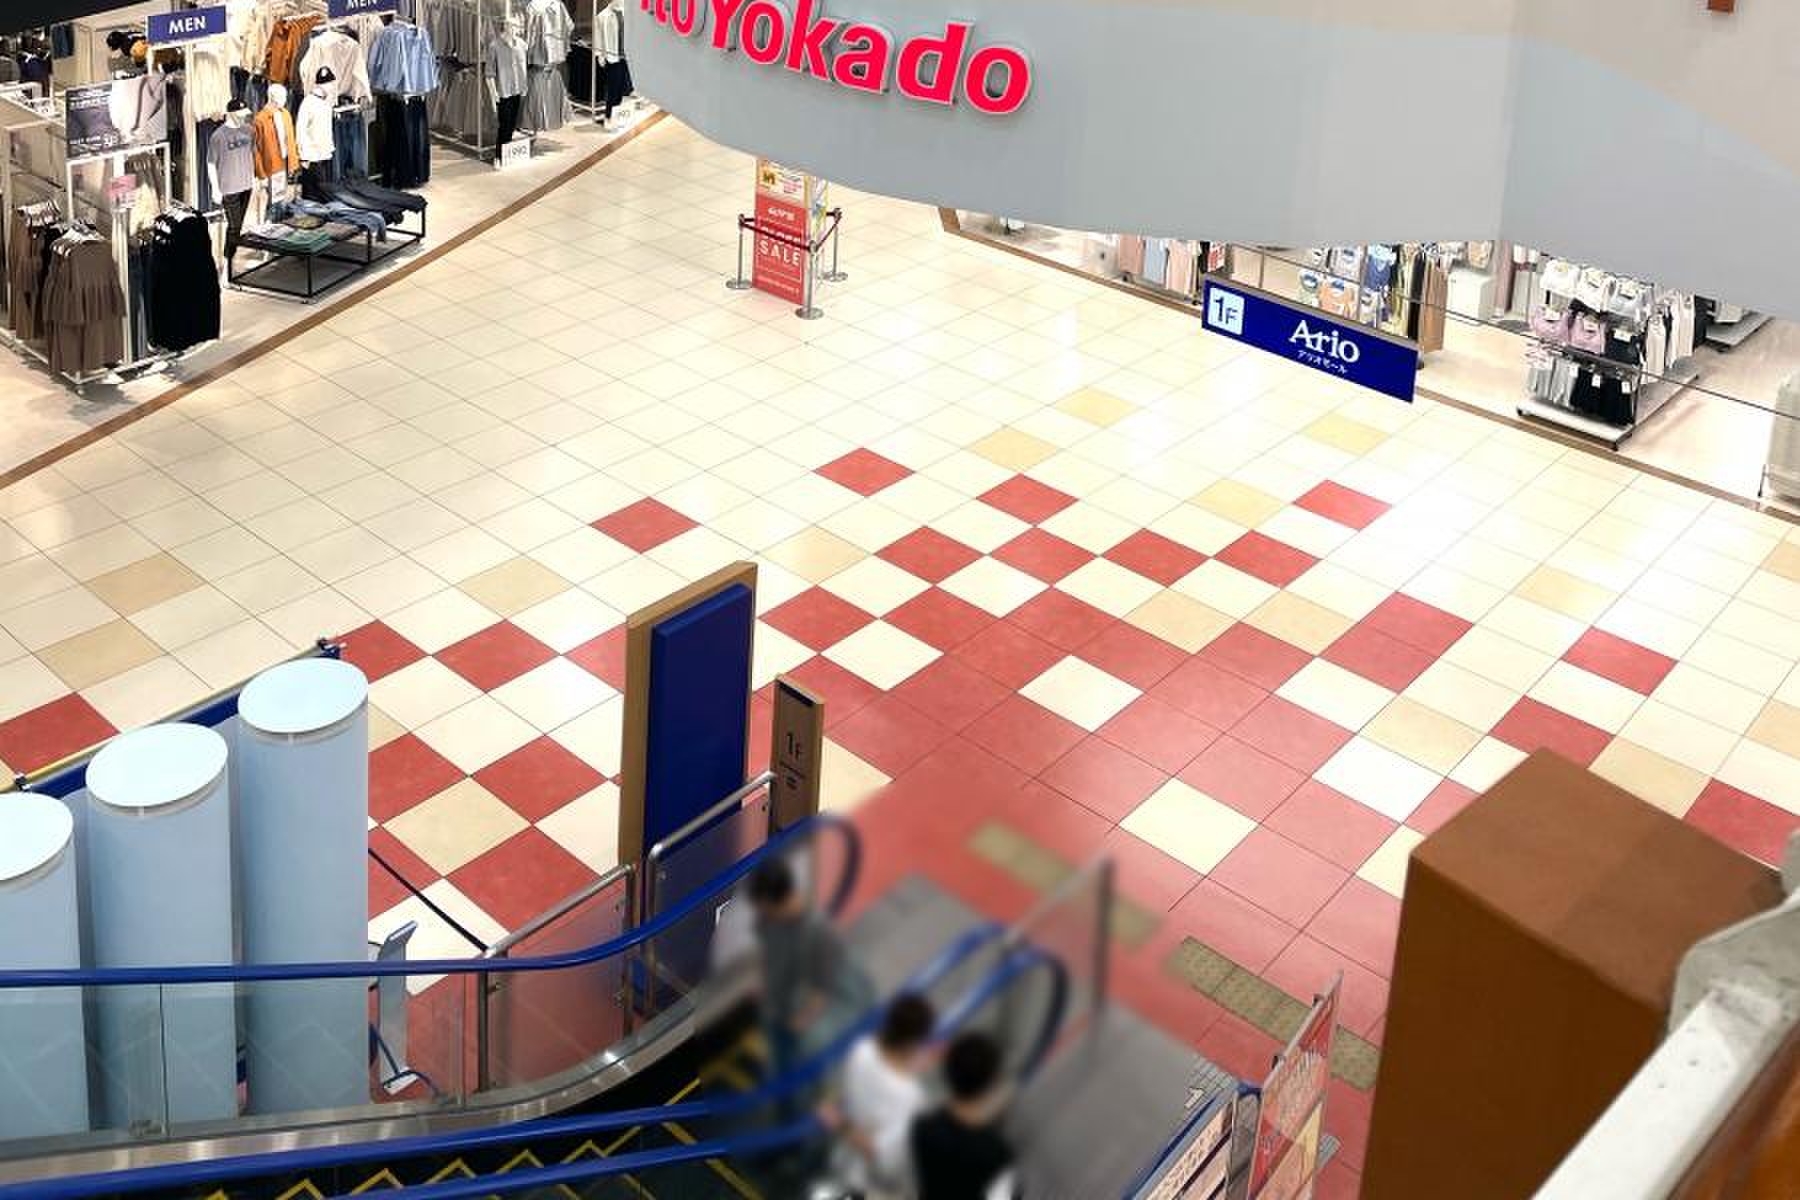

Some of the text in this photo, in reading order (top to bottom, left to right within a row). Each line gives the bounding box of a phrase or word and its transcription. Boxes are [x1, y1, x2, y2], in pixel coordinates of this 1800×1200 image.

[168, 14, 207, 35] MEN
[758, 237, 801, 267] SALE
[1214, 296, 1238, 326] 1F
[1288, 319, 1361, 364] Ario
